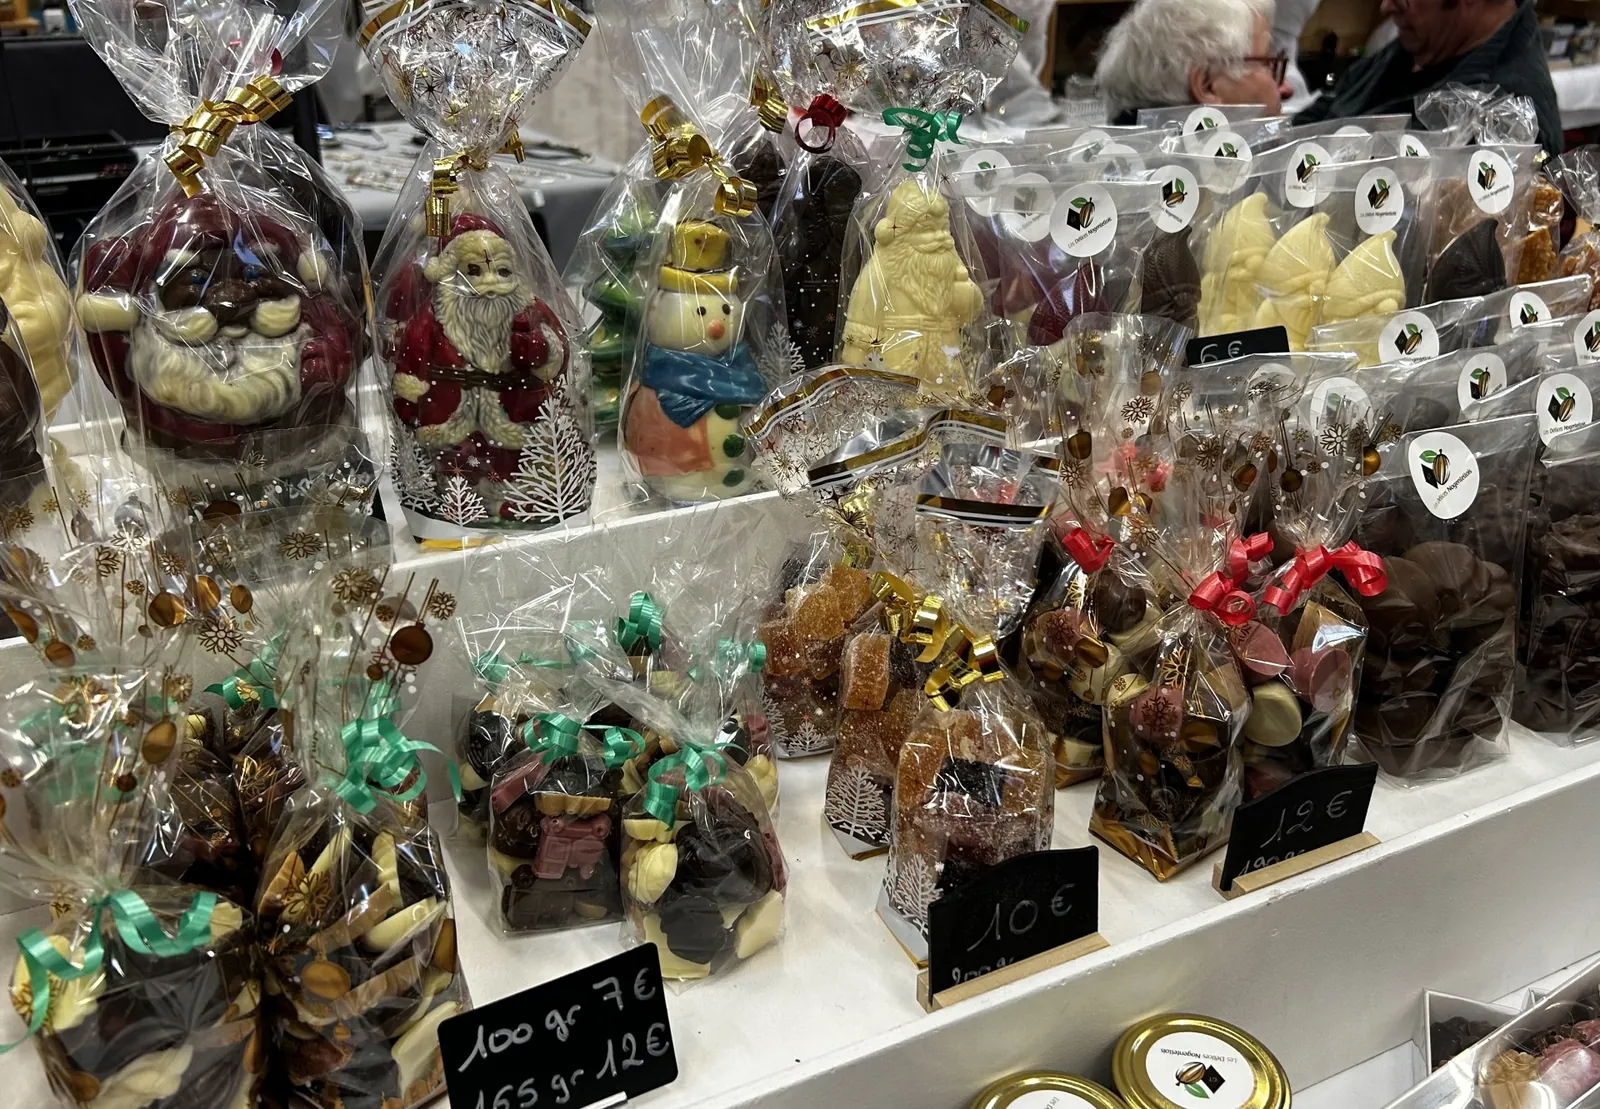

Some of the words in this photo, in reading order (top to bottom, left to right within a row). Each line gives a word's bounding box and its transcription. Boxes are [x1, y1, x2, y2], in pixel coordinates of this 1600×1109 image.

[1200, 343, 1218, 364] 6
[1260, 800, 1314, 849] 12
[1326, 790, 1352, 818] €
[966, 900, 1039, 952] 10
[1051, 883, 1076, 917] €
[458, 1023, 534, 1072] 100
[545, 1005, 581, 1042] gr
[592, 976, 624, 1011] 7
[633, 967, 656, 1001] €
[1226, 1056, 1238, 1064] Les
[551, 1069, 584, 1103] gr
